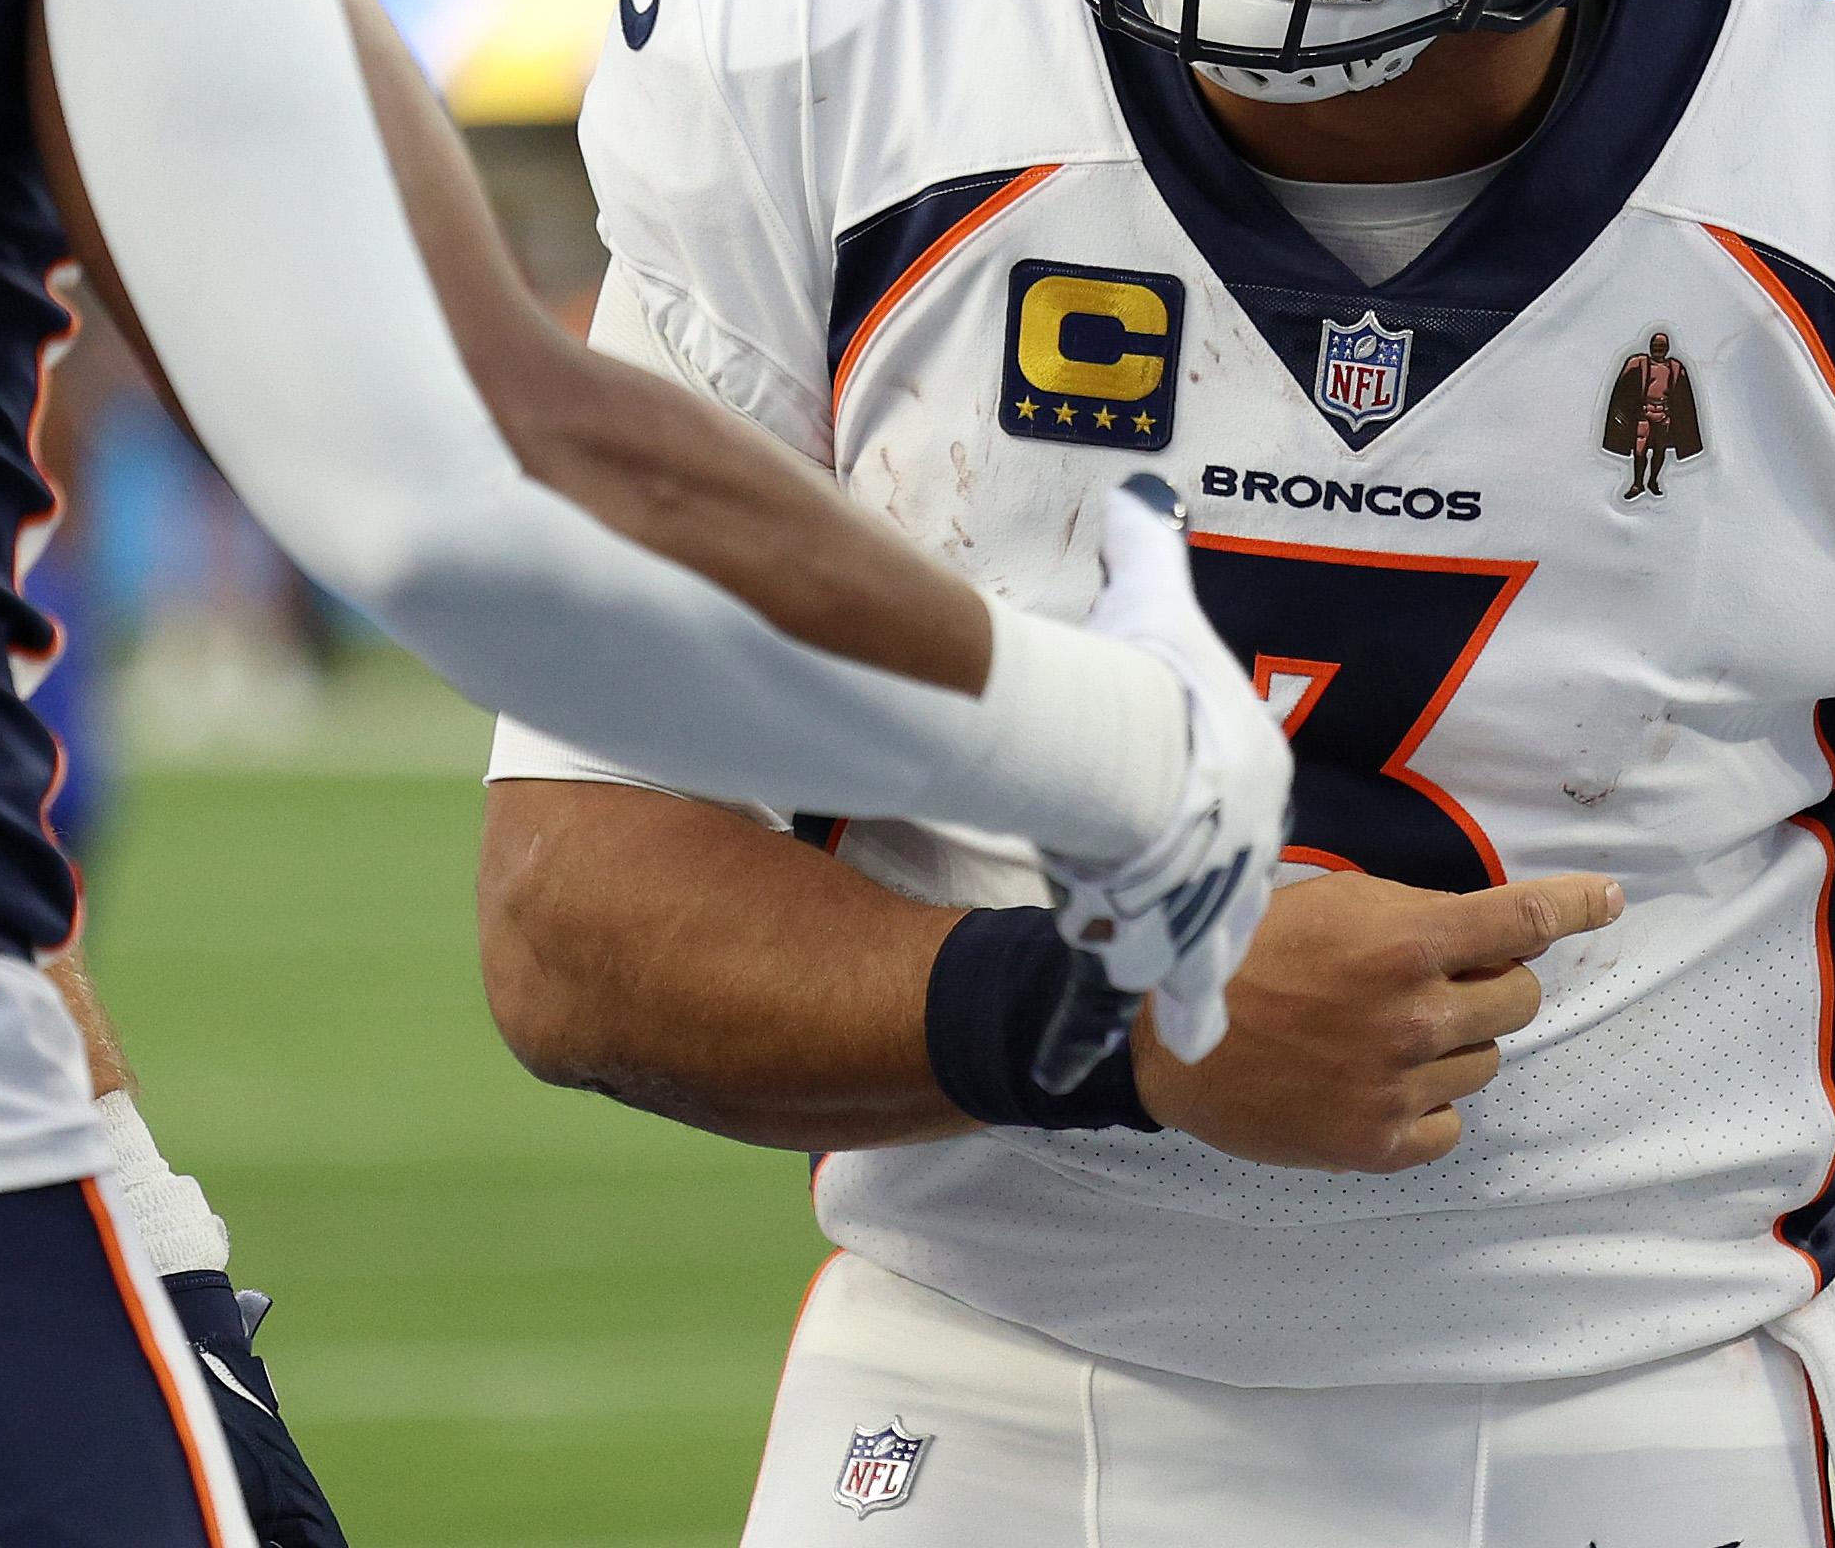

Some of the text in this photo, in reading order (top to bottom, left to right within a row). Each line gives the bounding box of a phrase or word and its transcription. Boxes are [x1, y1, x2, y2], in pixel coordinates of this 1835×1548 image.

[1017, 275, 1169, 403] C
[1328, 362, 1391, 411] NFL
[1201, 464, 1483, 522] BRONCOS
[845, 1460, 900, 1498] NFL
